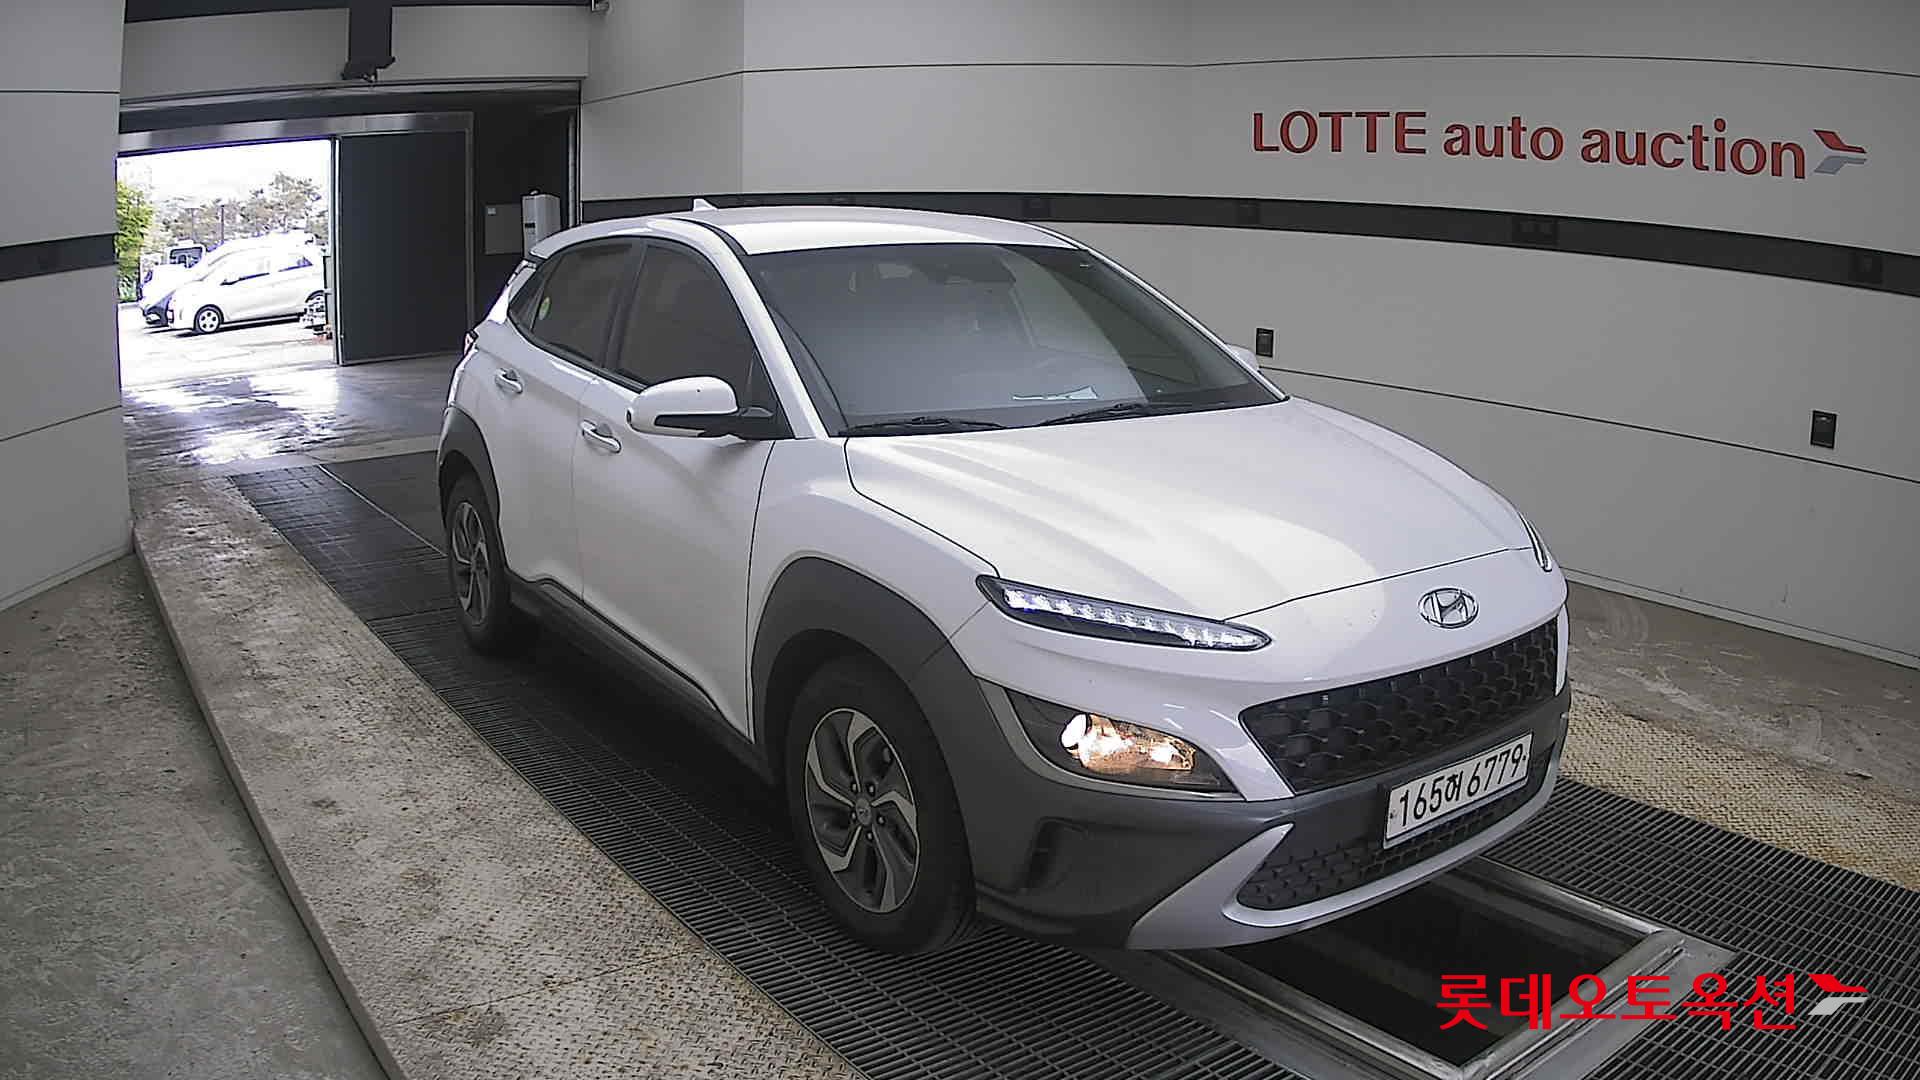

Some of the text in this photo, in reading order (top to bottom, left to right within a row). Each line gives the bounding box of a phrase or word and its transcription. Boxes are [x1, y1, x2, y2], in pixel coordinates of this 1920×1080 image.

[1252, 111, 1806, 180] LOTTE auto auction
